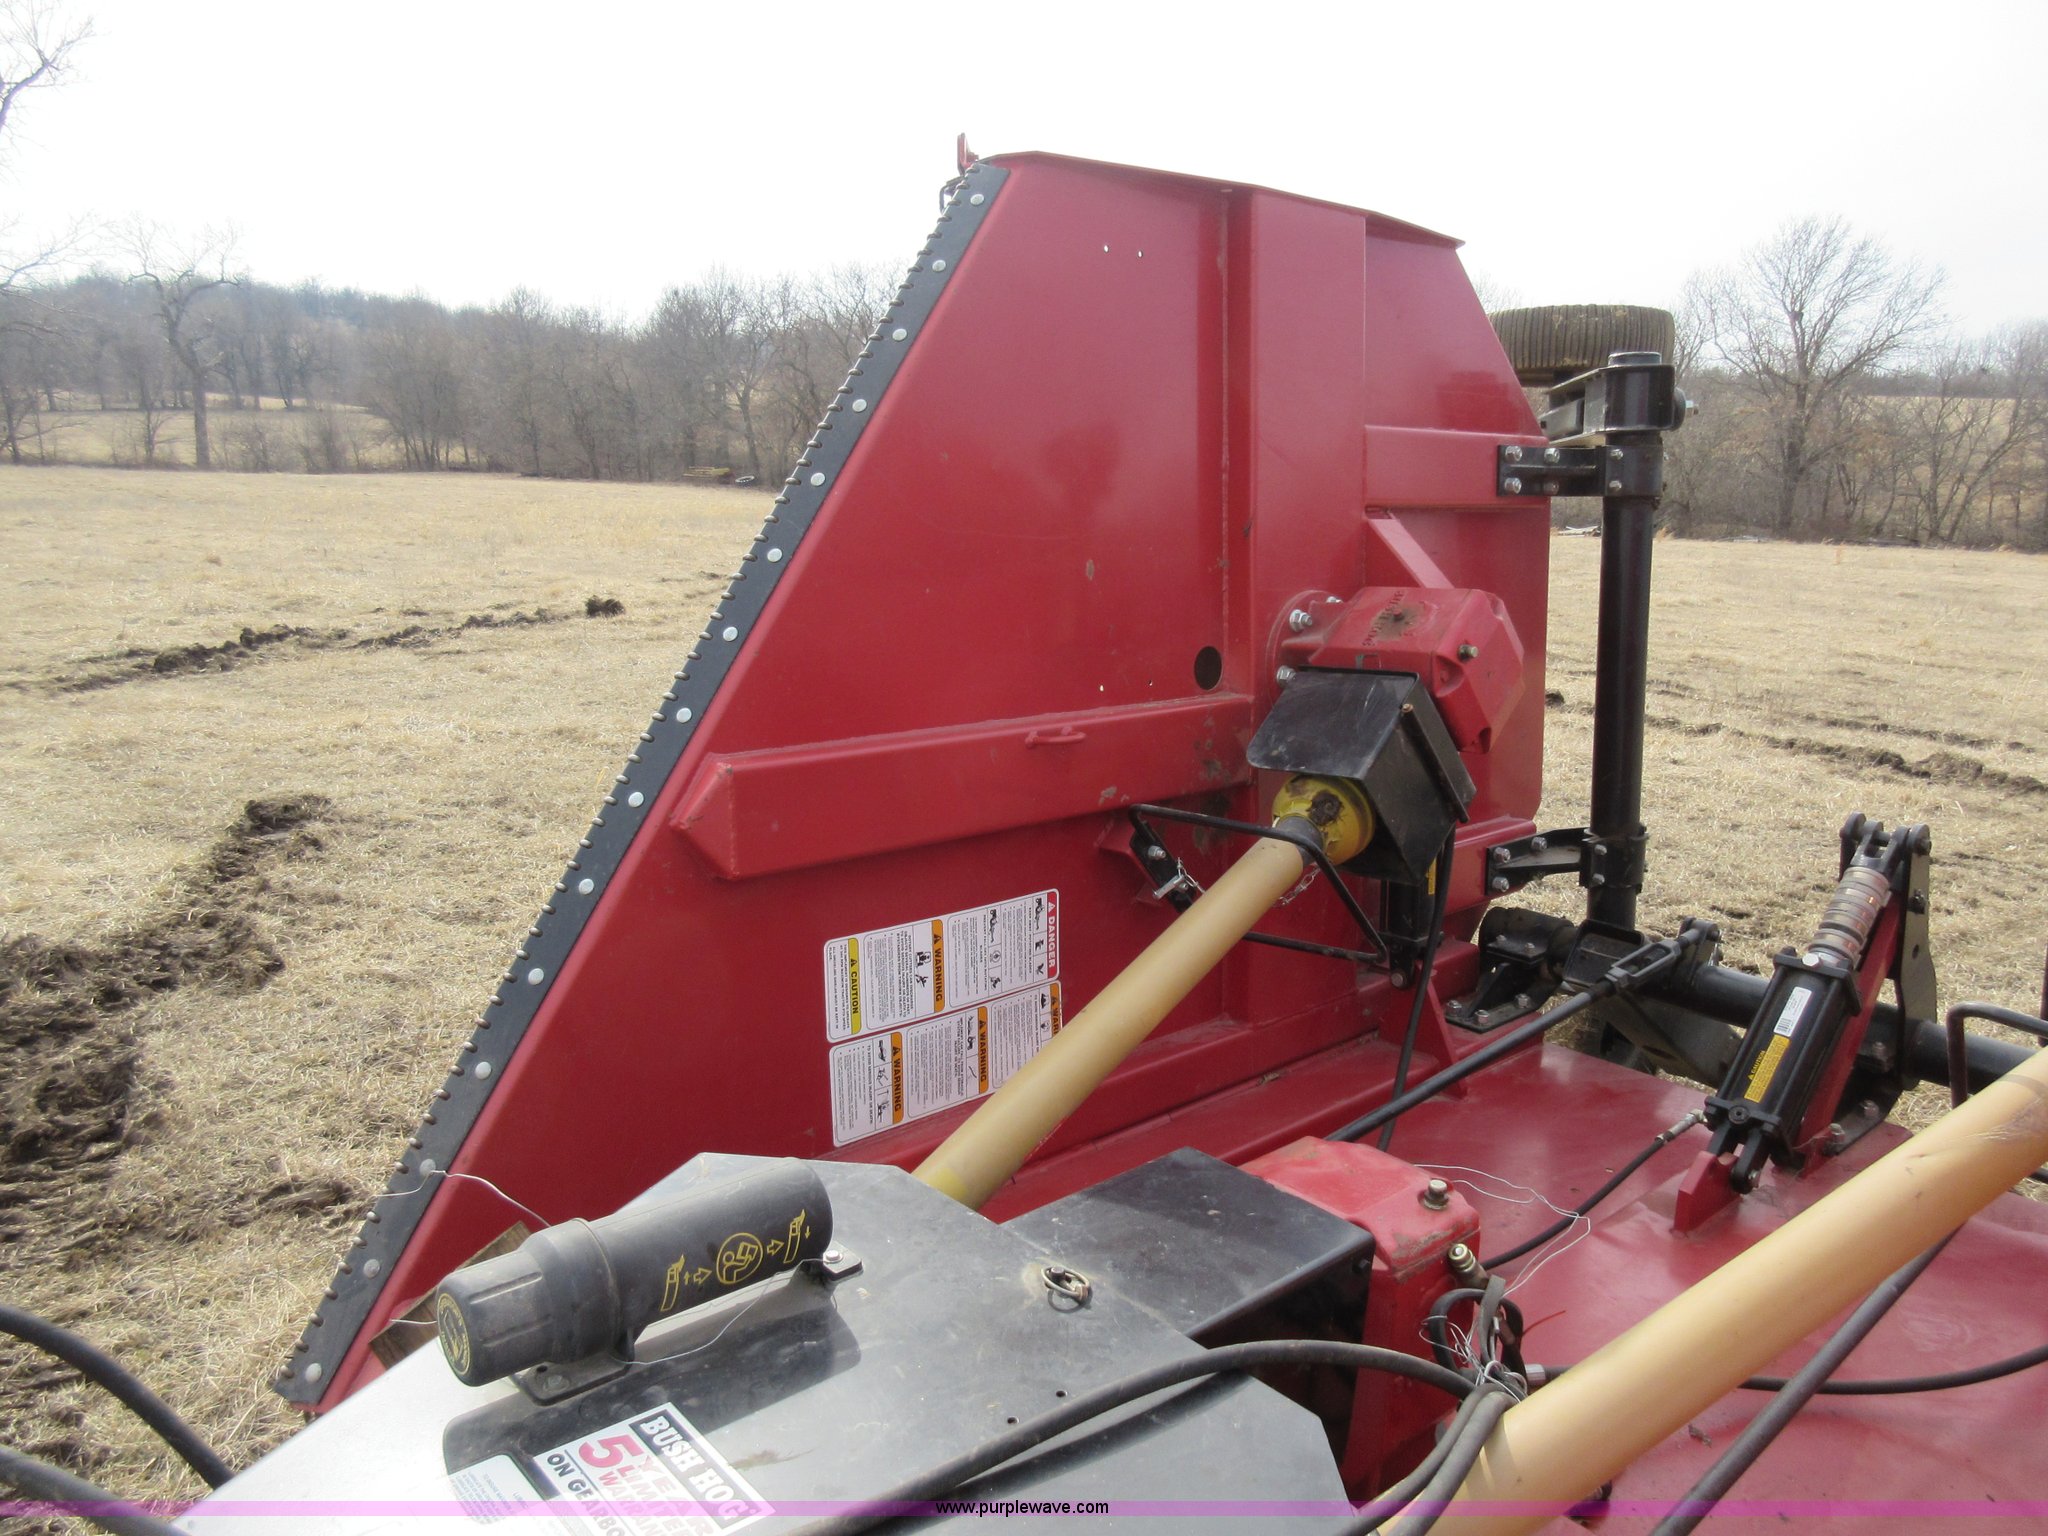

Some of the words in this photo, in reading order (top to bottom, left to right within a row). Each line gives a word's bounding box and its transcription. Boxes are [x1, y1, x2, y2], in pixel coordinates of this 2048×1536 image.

[1047, 915, 1055, 968] DANGER
[850, 970, 858, 1014] CAUTION
[934, 947, 942, 1002] WARNING
[978, 1032, 988, 1082] WARNING
[892, 1058, 902, 1112] WARNING
[546, 1453, 574, 1479] ON
[578, 1434, 643, 1468] 5
[640, 1415, 705, 1473] BUSH
[688, 1466, 751, 1521] HOG
